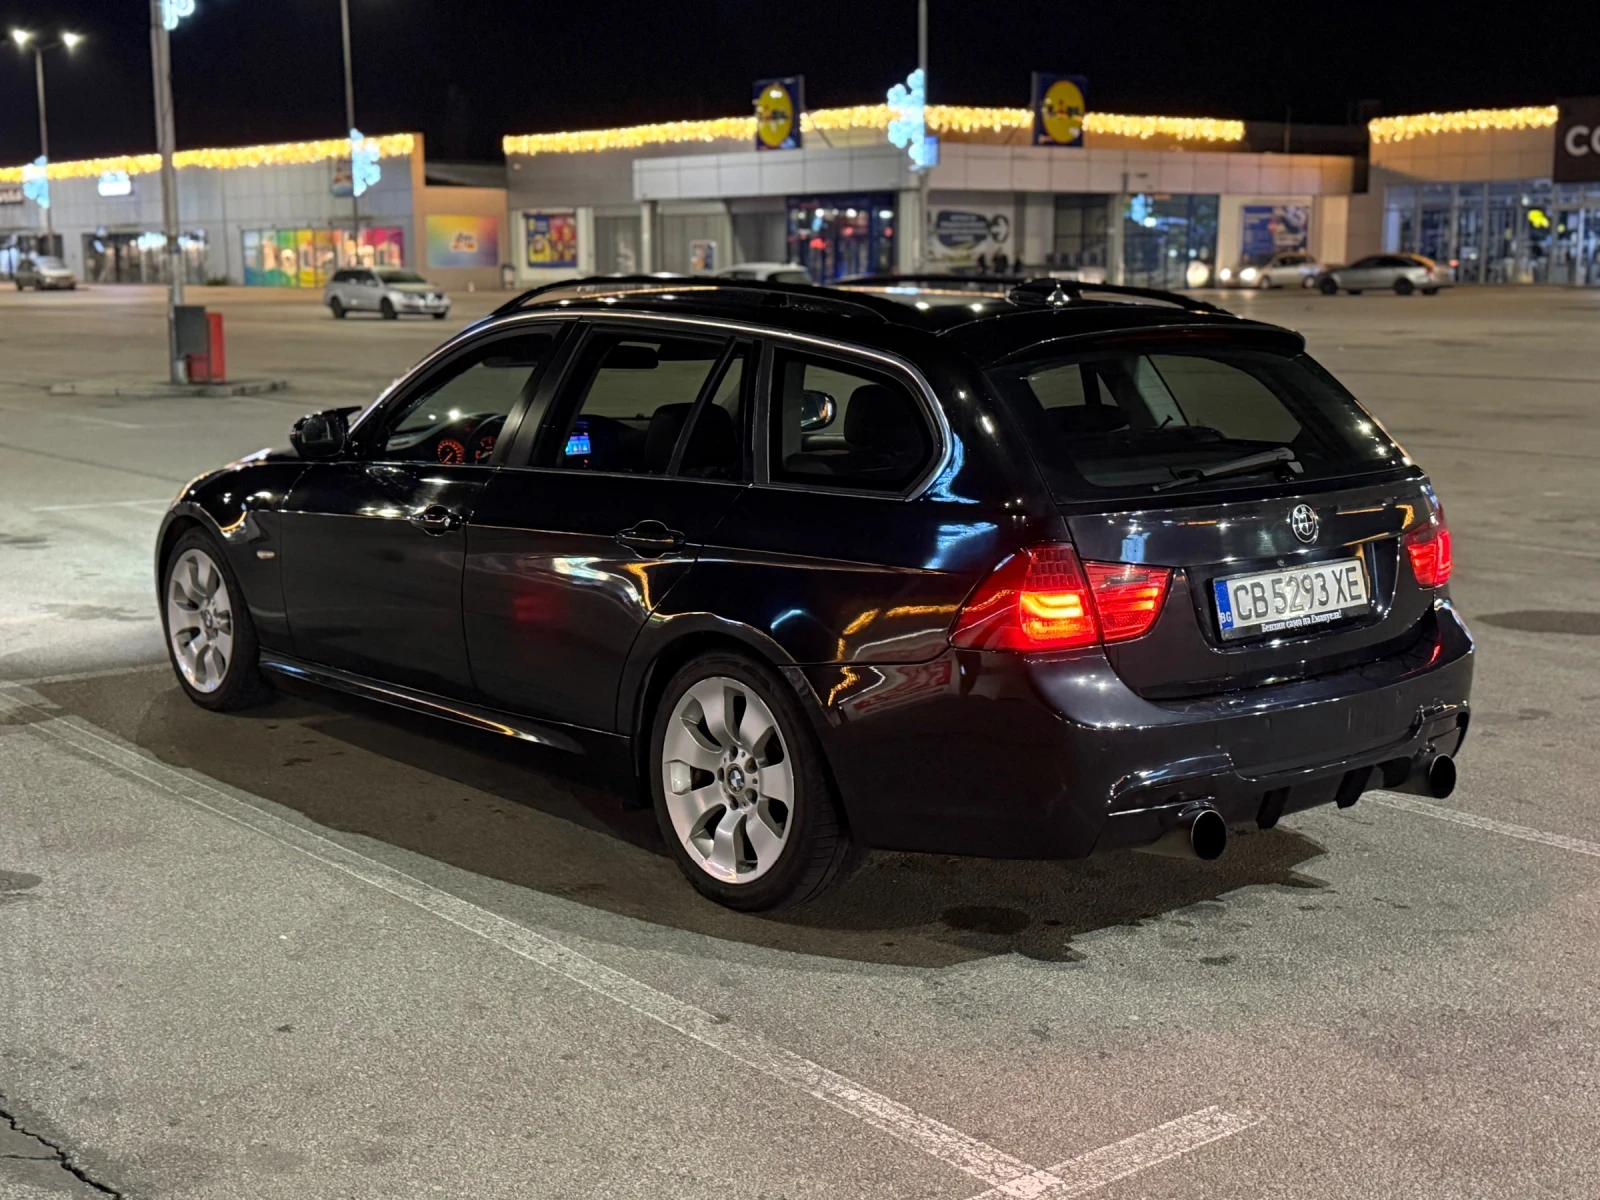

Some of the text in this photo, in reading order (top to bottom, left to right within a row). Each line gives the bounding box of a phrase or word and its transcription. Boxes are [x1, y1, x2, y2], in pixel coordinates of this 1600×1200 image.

[1233, 566, 1361, 621] CB 5293 XE
[1219, 612, 1232, 624] BG
